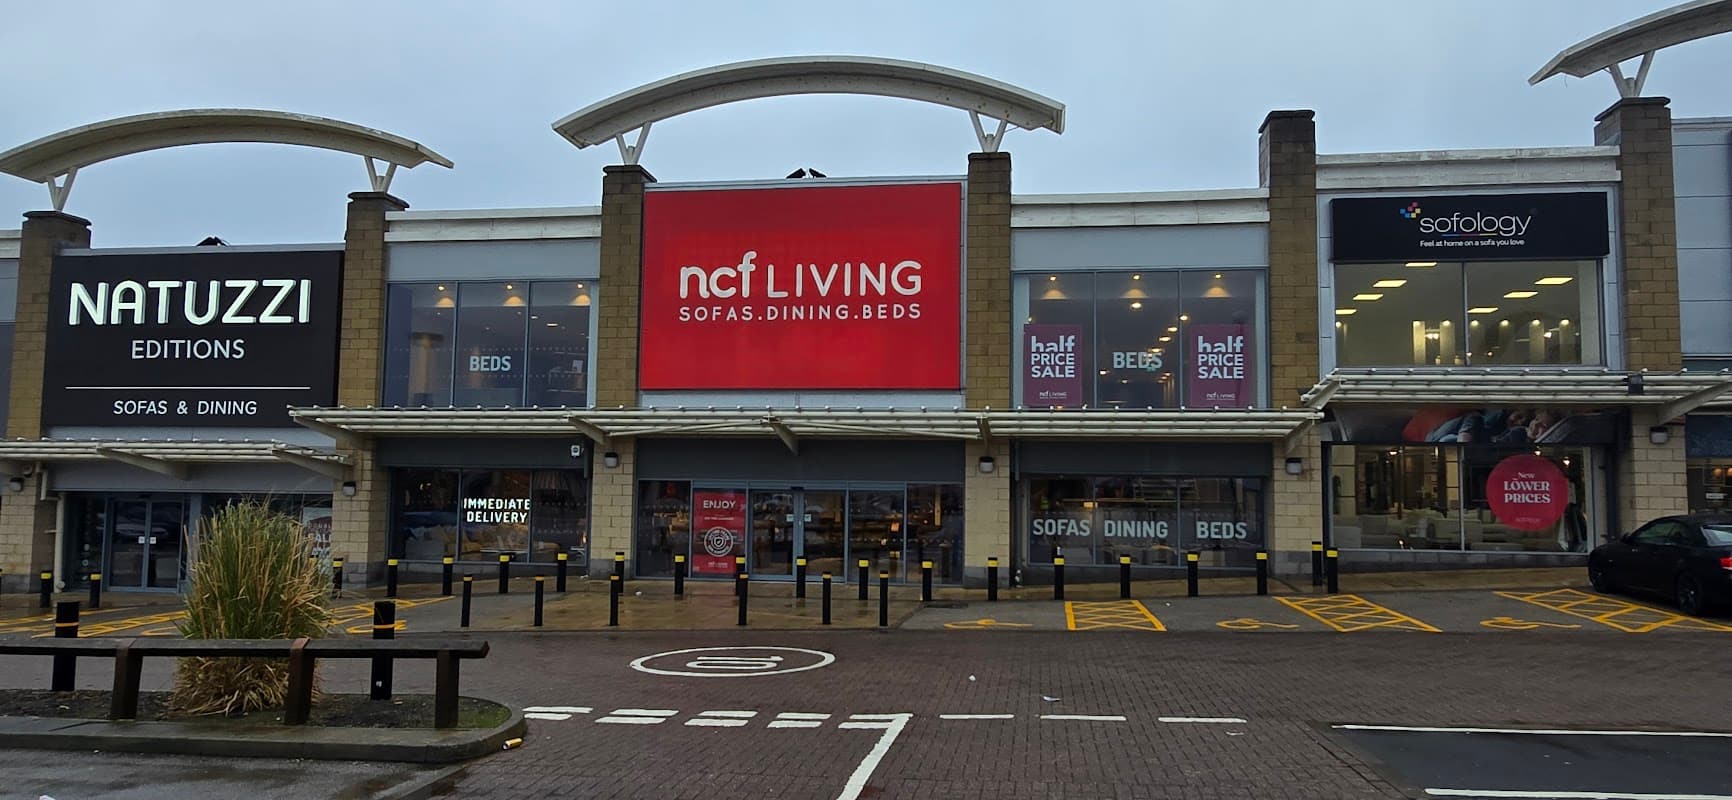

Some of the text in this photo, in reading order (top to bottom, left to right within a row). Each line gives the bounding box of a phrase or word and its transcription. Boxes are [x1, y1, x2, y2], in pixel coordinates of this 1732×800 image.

[1419, 211, 1532, 237] sofology
[1443, 239, 1463, 247] home
[679, 250, 922, 299] ncf LIVING
[68, 279, 312, 326] NATUZZI
[131, 339, 245, 360] EDITIONS
[1031, 335, 1075, 352] half
[1197, 335, 1244, 353] half
[469, 355, 512, 372] BEDS
[1031, 353, 1075, 365] PRICE
[1113, 351, 1163, 369] BEDS
[1198, 353, 1244, 366] PRICE
[1031, 366, 1075, 378] SALE
[1198, 366, 1244, 379] SALE
[113, 400, 257, 416] SOFAS & DINING
[1517, 472, 1535, 480] New
[1503, 480, 1550, 491] LOWER
[463, 498, 531, 510] IMMEDIATE
[703, 500, 736, 509] ENJOY
[1504, 493, 1551, 504] PRICES
[466, 511, 528, 523] DELIVERY
[1032, 518, 1247, 539] SOFAS DINING BEDS
[686, 656, 784, 670] 10
